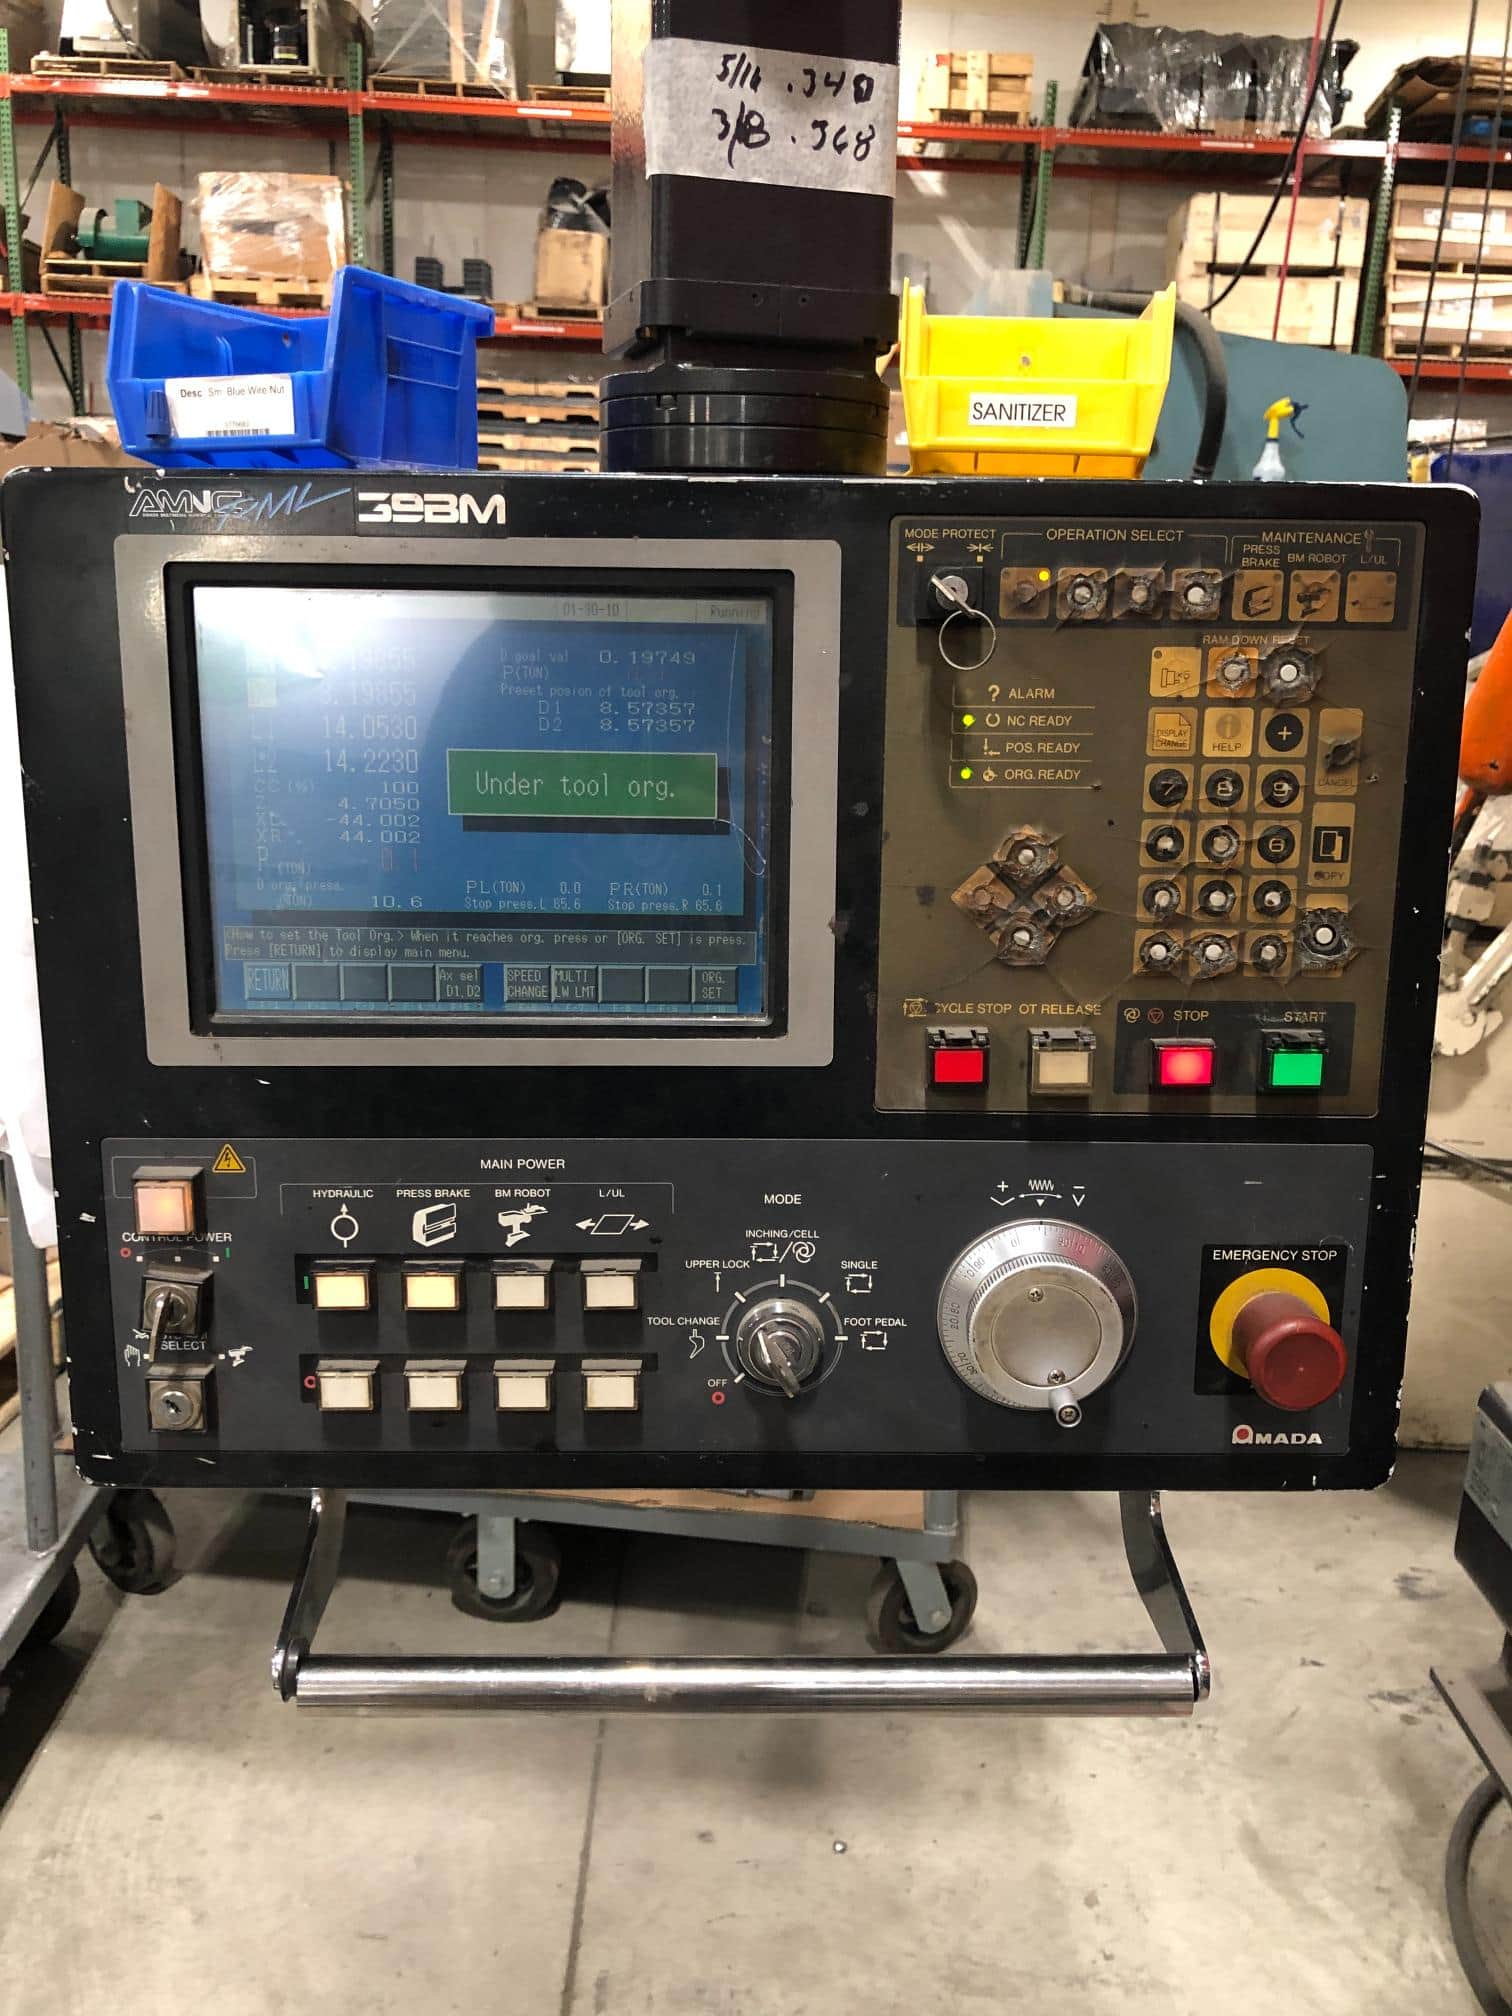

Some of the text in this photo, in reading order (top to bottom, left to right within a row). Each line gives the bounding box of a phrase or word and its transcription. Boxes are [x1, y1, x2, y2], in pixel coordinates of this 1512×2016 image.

[226, 386, 246, 396] Blue
[269, 384, 285, 394] Nut
[972, 402, 1067, 422] SANITIZER
[358, 491, 507, 525] 39BM
[904, 528, 996, 539] MODE PROTECT
[1046, 528, 1185, 542] OPERATION SELECT
[1261, 531, 1362, 545] MAINTENANCE
[1243, 543, 1281, 555] PRESS
[1241, 557, 1281, 568] BRAKE
[1287, 553, 1347, 564] BM ROBOT
[1202, 634, 1229, 645] RAM
[1231, 634, 1269, 646] DOWN
[1008, 688, 1056, 699] ALARM
[538, 700, 697, 715] D1 8.57357
[538, 717, 697, 733] D2 8.57357
[1007, 715, 1073, 727] NC READY
[1157, 729, 1189, 738] DISPLAY
[1005, 742, 1081, 753] POS. READY
[1212, 742, 1243, 752] HELP
[1004, 769, 1081, 780] ORG. READY
[383, 781, 420, 794] 100
[475, 770, 676, 800] Under tool org.
[1313, 870, 1346, 881] OPY
[371, 895, 423, 908] 10.6
[463, 896, 492, 911] Stop
[607, 898, 636, 913] Stop
[260, 928, 273, 941] to
[307, 929, 329, 942] the
[410, 928, 439, 943] When
[466, 931, 514, 944] reaches
[329, 945, 344, 957] to
[349, 945, 398, 959] display
[404, 947, 433, 958] main
[248, 967, 290, 993] RETURN
[507, 969, 542, 983] SPEED
[554, 969, 589, 983] MULTI
[507, 985, 549, 999] CHANGE
[574, 986, 597, 999] LMT
[701, 986, 722, 1000] SET
[977, 1003, 1012, 1014] STOP
[1018, 1003, 1102, 1016] OT RELEASE
[1173, 1010, 1209, 1021] STOP
[1283, 1010, 1327, 1023] START
[480, 1159, 566, 1170] MAIN POWER
[312, 1189, 374, 1198] HYDRAULIC
[396, 1189, 471, 1198] PRESS BRAKE
[494, 1188, 551, 1198] BM ROBOT
[599, 1188, 625, 1198] L/UL
[764, 1194, 802, 1205] MODE
[186, 1232, 233, 1242] POWER
[745, 1229, 820, 1239] INCHING/CELL
[1213, 1250, 1338, 1261] EMERGENCY STOP
[685, 1260, 750, 1269] UPPER LOCK
[840, 1260, 879, 1270] SINGLE
[647, 1316, 721, 1326] TOOL CHANGE
[844, 1317, 908, 1327] FOOT PEDAL
[161, 1340, 206, 1351] SELECT
[707, 1379, 728, 1387] OFF
